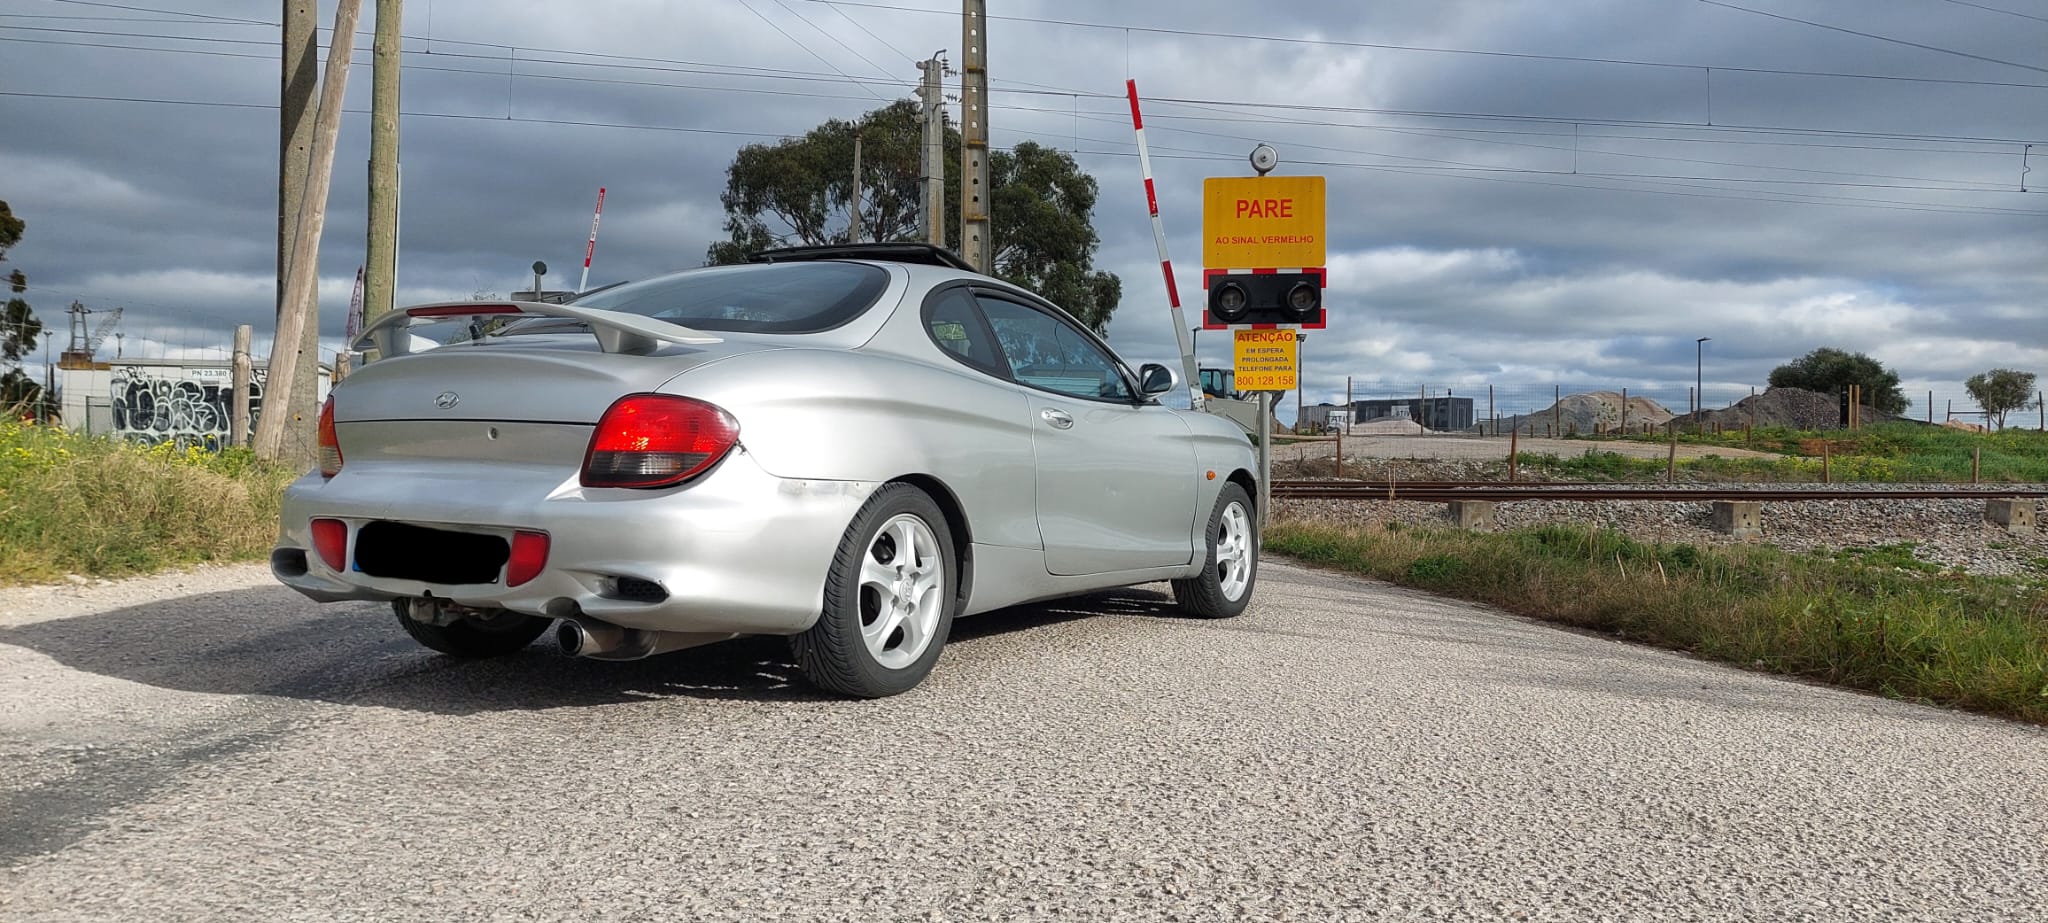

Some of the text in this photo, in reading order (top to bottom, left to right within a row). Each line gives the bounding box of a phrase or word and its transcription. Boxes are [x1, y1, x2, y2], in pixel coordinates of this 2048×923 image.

[1236, 199, 1293, 218] PARE
[1215, 235, 1314, 245] AO SINAL VERMELHO
[1237, 331, 1293, 344] ATENÇÃO
[1236, 375, 1294, 386] 800 128 158
